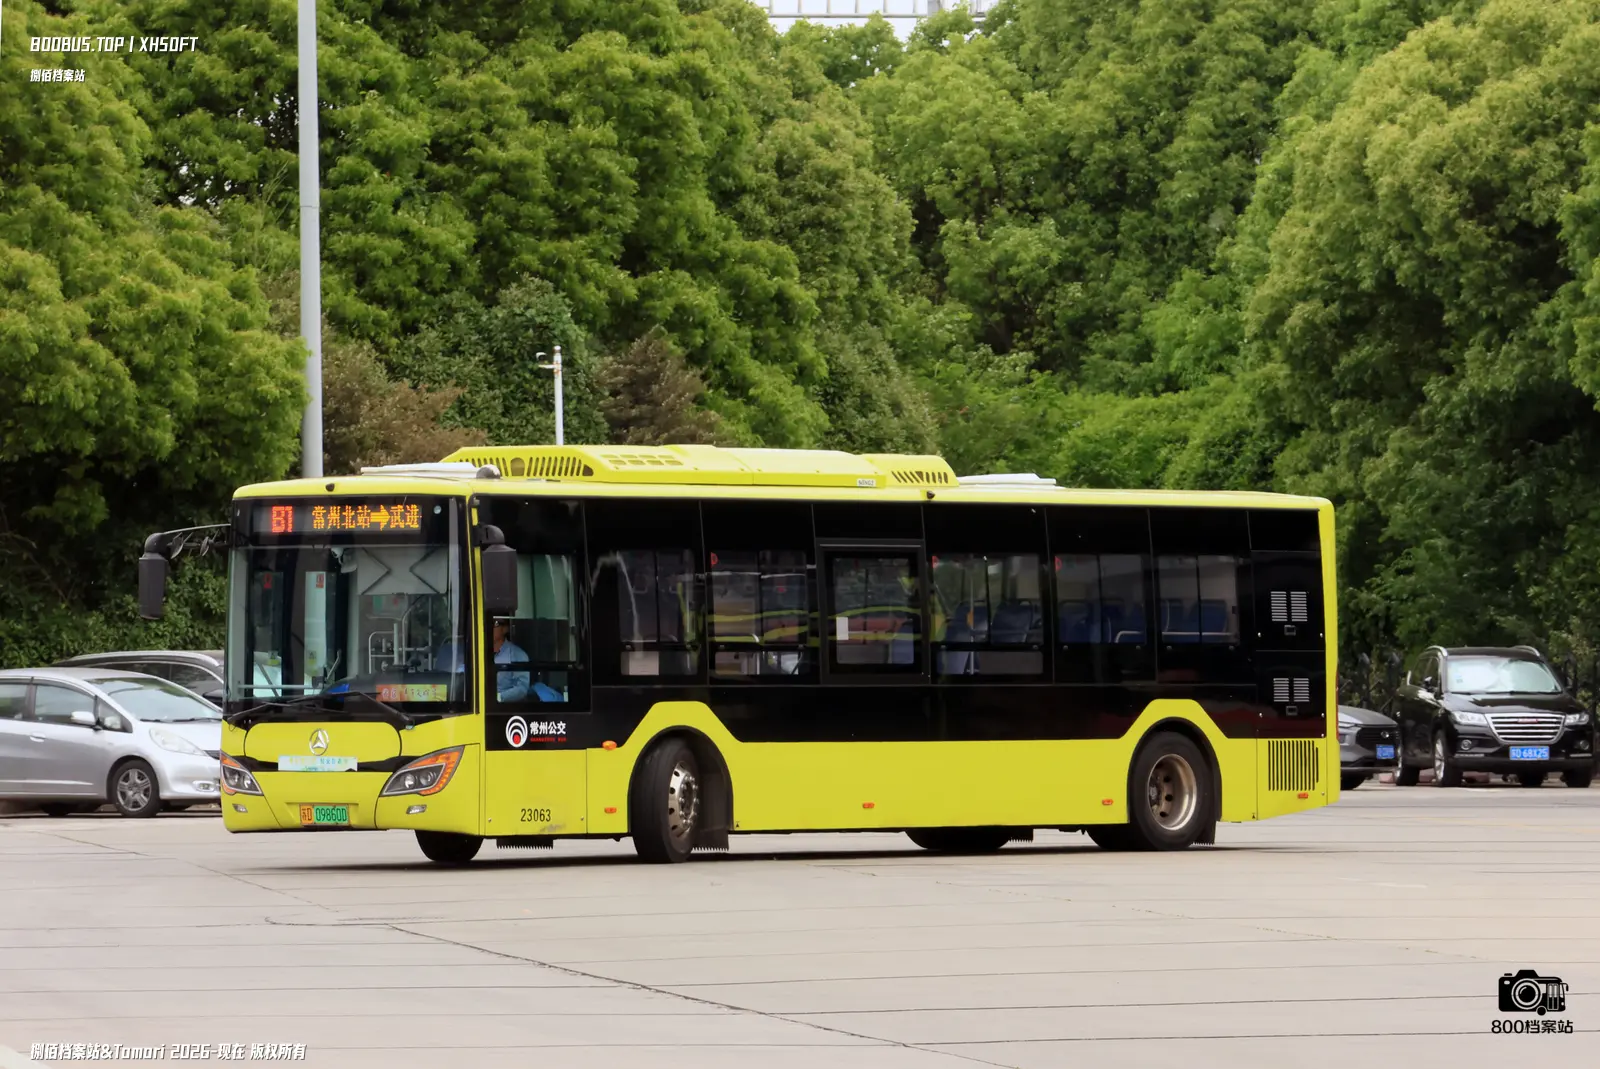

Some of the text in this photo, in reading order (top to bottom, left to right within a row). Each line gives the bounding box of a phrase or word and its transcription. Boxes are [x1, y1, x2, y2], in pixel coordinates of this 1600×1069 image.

[271, 505, 293, 533] B1
[312, 504, 420, 529] 常州北站 武进
[529, 720, 567, 735] 常州公交
[520, 808, 551, 822] 23063
